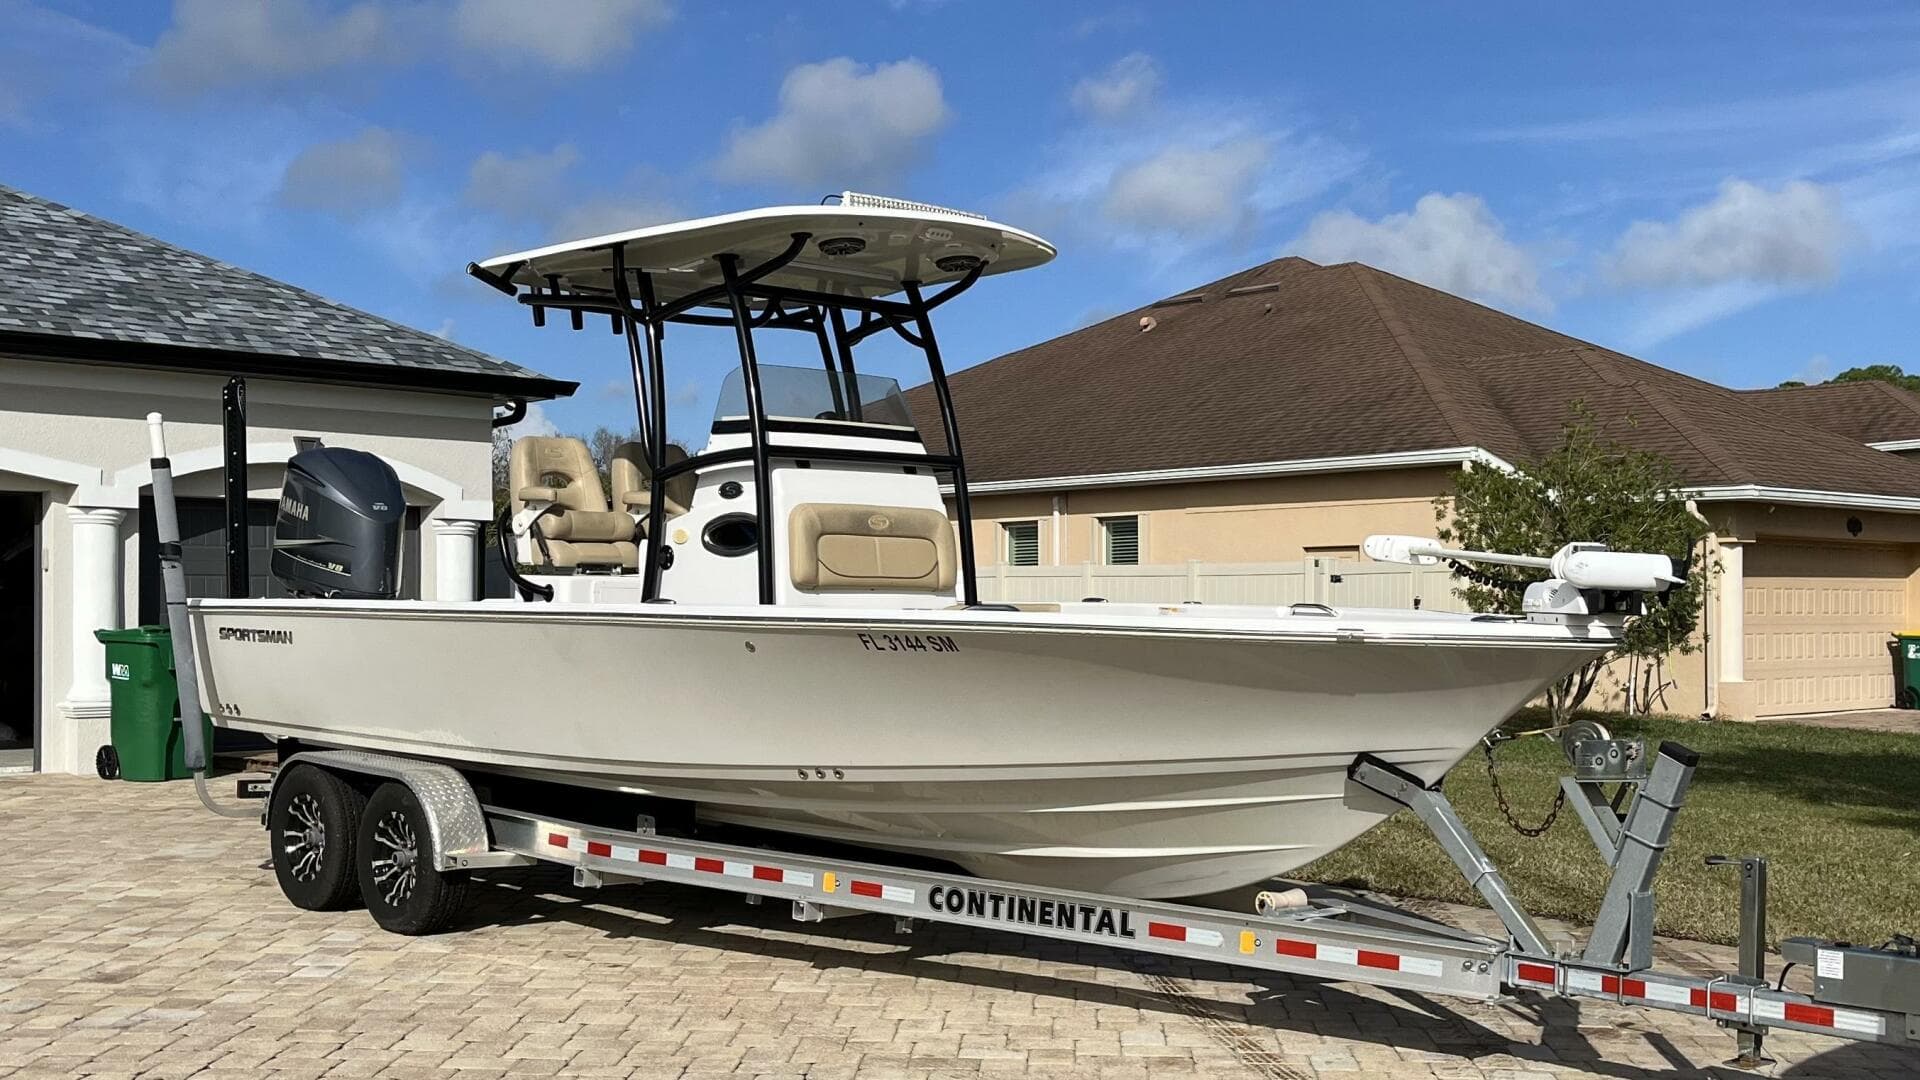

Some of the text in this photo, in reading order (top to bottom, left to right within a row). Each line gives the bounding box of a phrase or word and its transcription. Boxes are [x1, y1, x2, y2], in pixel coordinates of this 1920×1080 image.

[279, 495, 309, 520] AMAHA
[328, 562, 344, 572] V8
[219, 627, 293, 645] SPORTSMAN
[857, 633, 960, 652] FL 3144 SM
[928, 884, 1136, 940] CONTINENTAL
